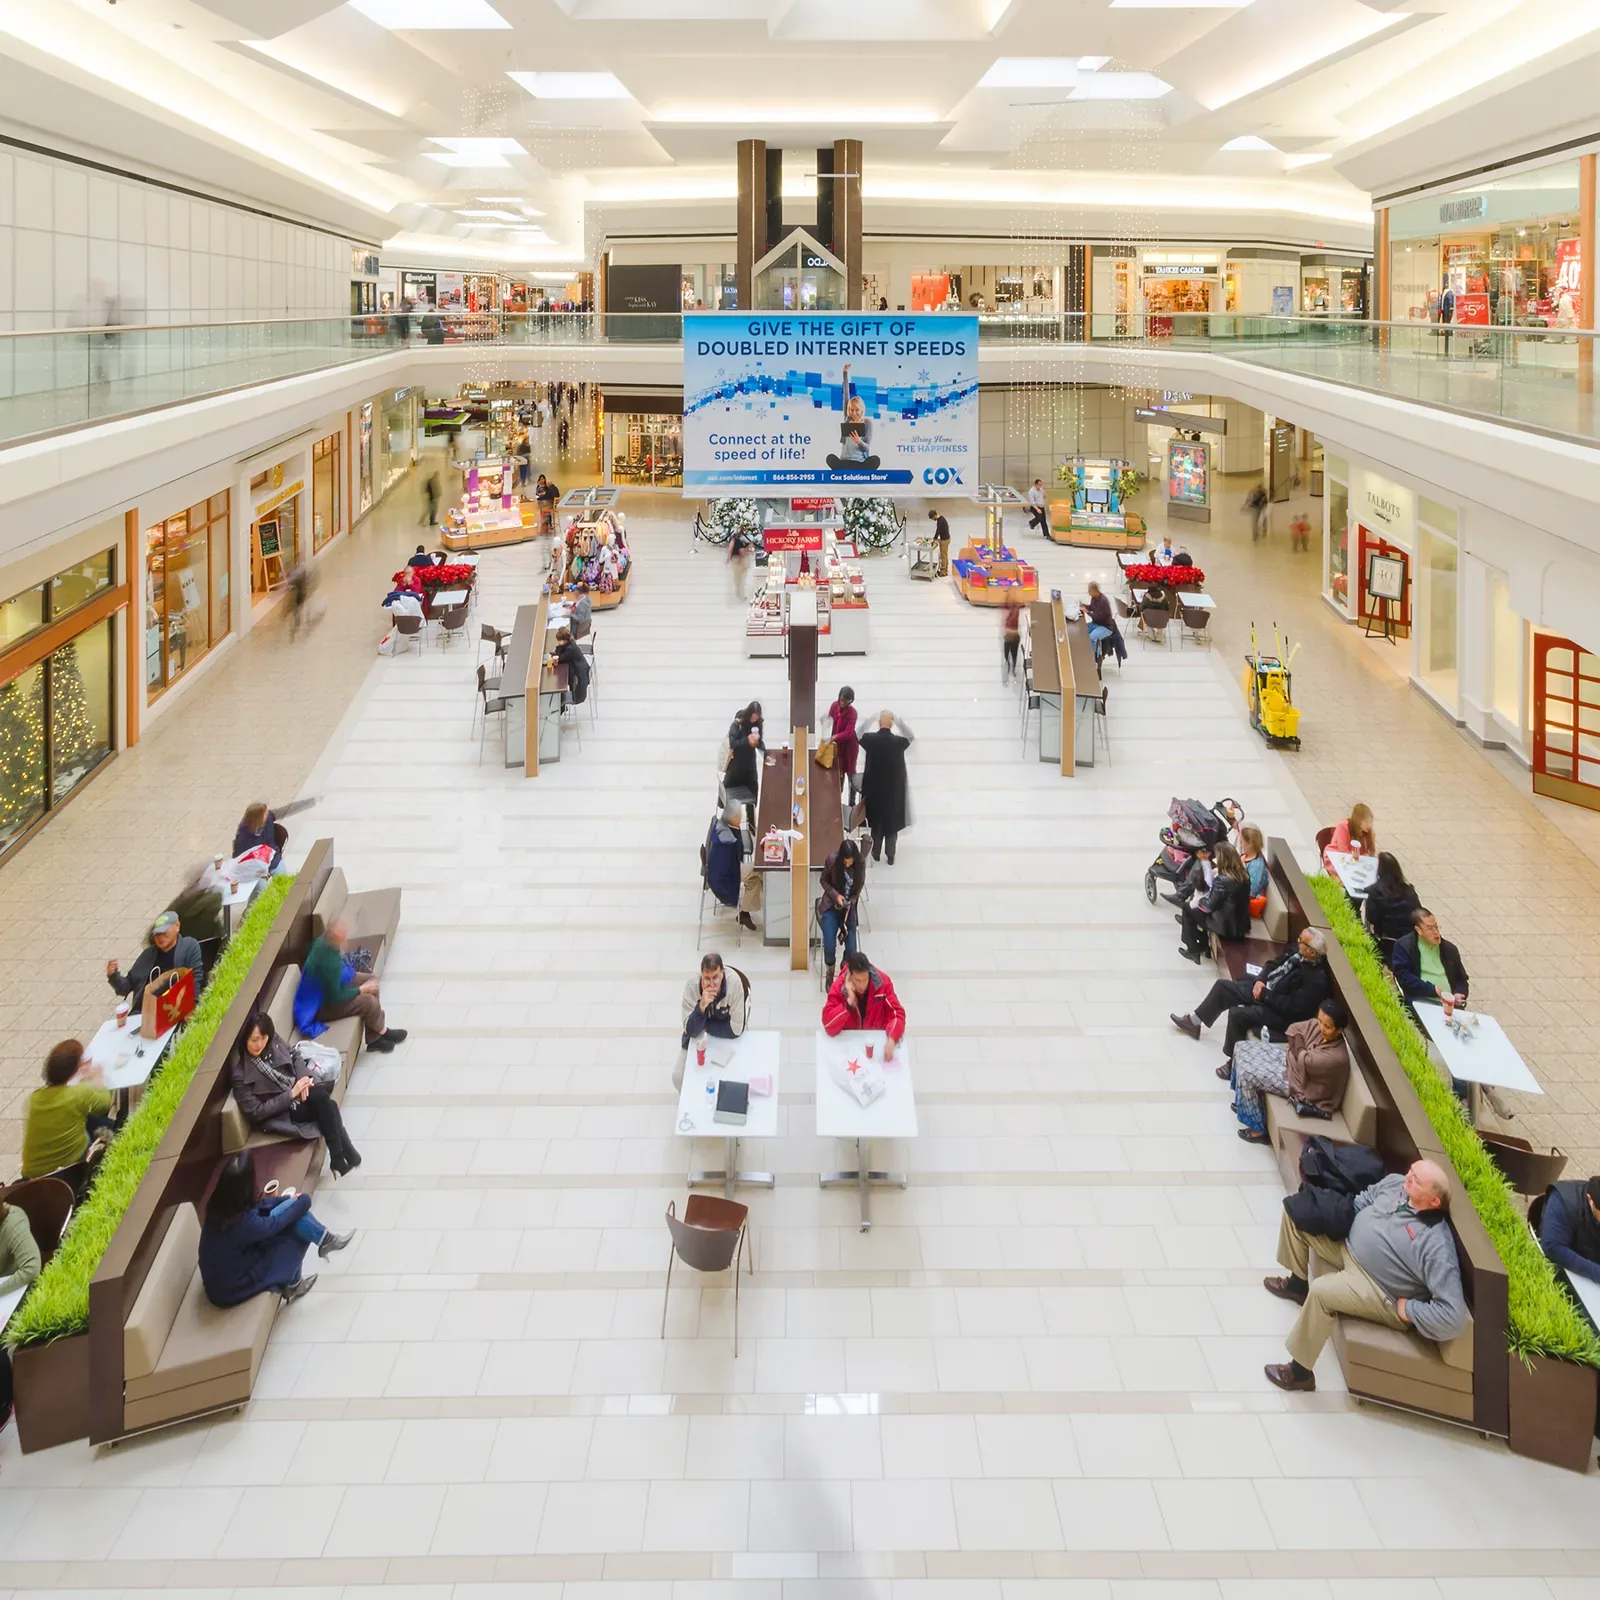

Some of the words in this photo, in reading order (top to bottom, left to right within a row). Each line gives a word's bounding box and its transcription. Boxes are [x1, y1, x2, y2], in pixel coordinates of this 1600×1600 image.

[748, 321, 792, 336] GIVE
[798, 321, 835, 336] THE
[841, 321, 883, 336] GIFT
[889, 321, 915, 336] OF
[697, 341, 789, 356] DOUBLED
[795, 341, 888, 356] INTERNET
[894, 341, 966, 356] SPEEDS
[708, 433, 767, 445] Connect
[771, 434, 784, 445] at
[789, 433, 811, 445] the
[911, 435, 932, 445] Bring
[933, 435, 953, 443] Home
[896, 445, 915, 453] THE
[917, 445, 968, 453] HAPPINESS
[714, 448, 757, 462] speed
[761, 448, 775, 460] of
[779, 448, 805, 460] life!
[707, 474, 758, 482] cox.com/internet
[772, 473, 816, 481] 866-856-2955
[830, 473, 842, 481] Cox
[843, 473, 870, 481] Solutions
[923, 467, 965, 486] COX
[1367, 491, 1400, 518] TALBOTS
[797, 536, 820, 544] FARMS
